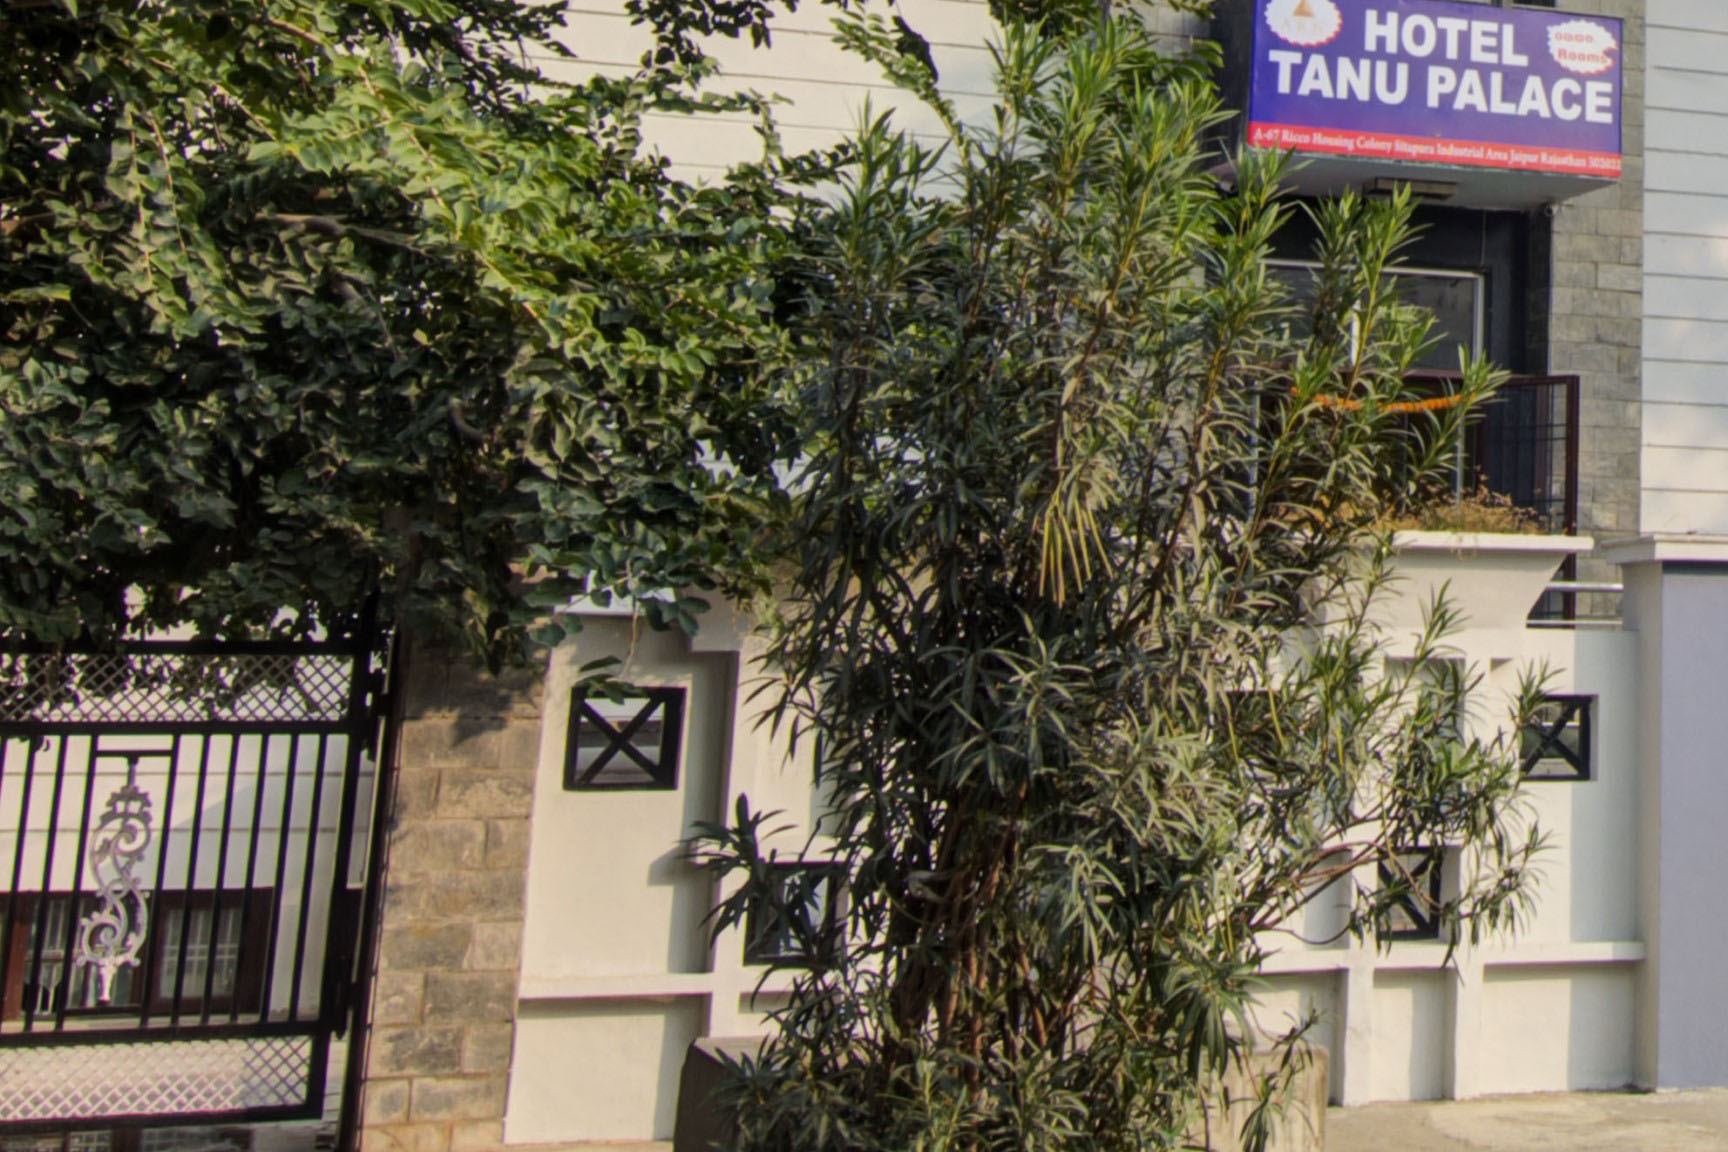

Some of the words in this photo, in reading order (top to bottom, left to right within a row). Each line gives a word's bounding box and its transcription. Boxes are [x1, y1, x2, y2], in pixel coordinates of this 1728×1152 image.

[1364, 8, 1529, 67] HOTEL
[1557, 47, 1607, 64] Rooms
[1268, 50, 1409, 105] TANU
[1427, 65, 1613, 124] PALACE
[1312, 132, 1354, 151] Housing
[1357, 136, 1392, 152] Colony
[1437, 143, 1484, 158] Industrial
[1486, 148, 1508, 161] Area
[1508, 149, 1539, 165] Jaipur
[1540, 152, 1587, 168] Rajasthan
